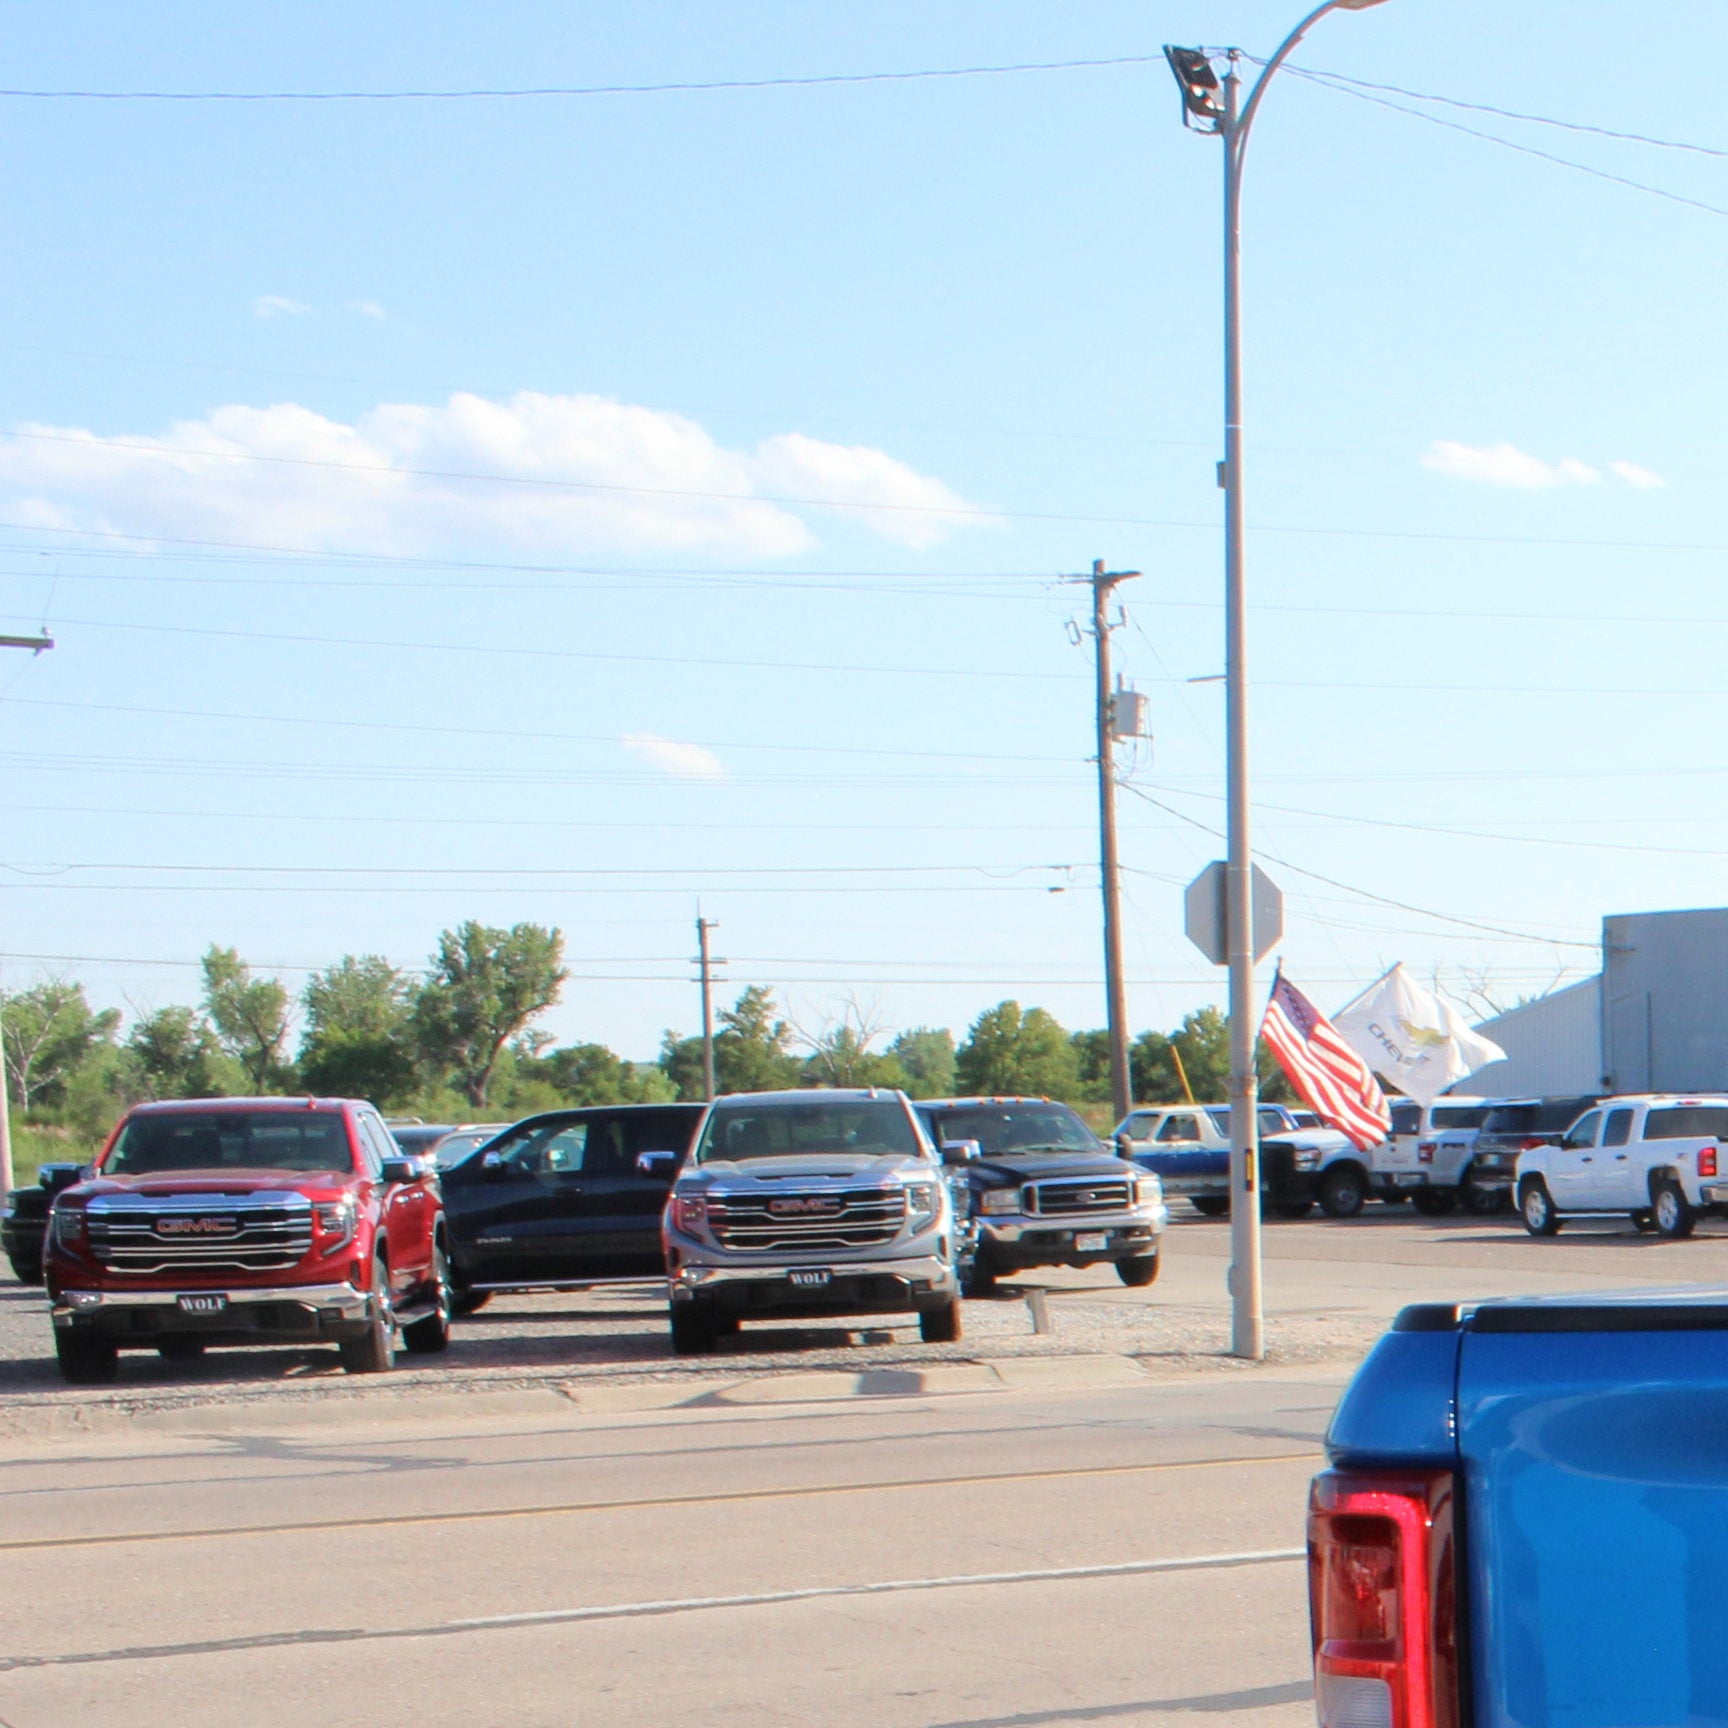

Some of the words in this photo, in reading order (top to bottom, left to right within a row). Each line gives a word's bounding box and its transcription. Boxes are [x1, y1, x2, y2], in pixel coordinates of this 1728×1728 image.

[768, 1198, 841, 1212] GMC
[157, 1218, 237, 1233] GMC
[788, 1271, 831, 1285] WOLF
[178, 1296, 226, 1311] WOLF
